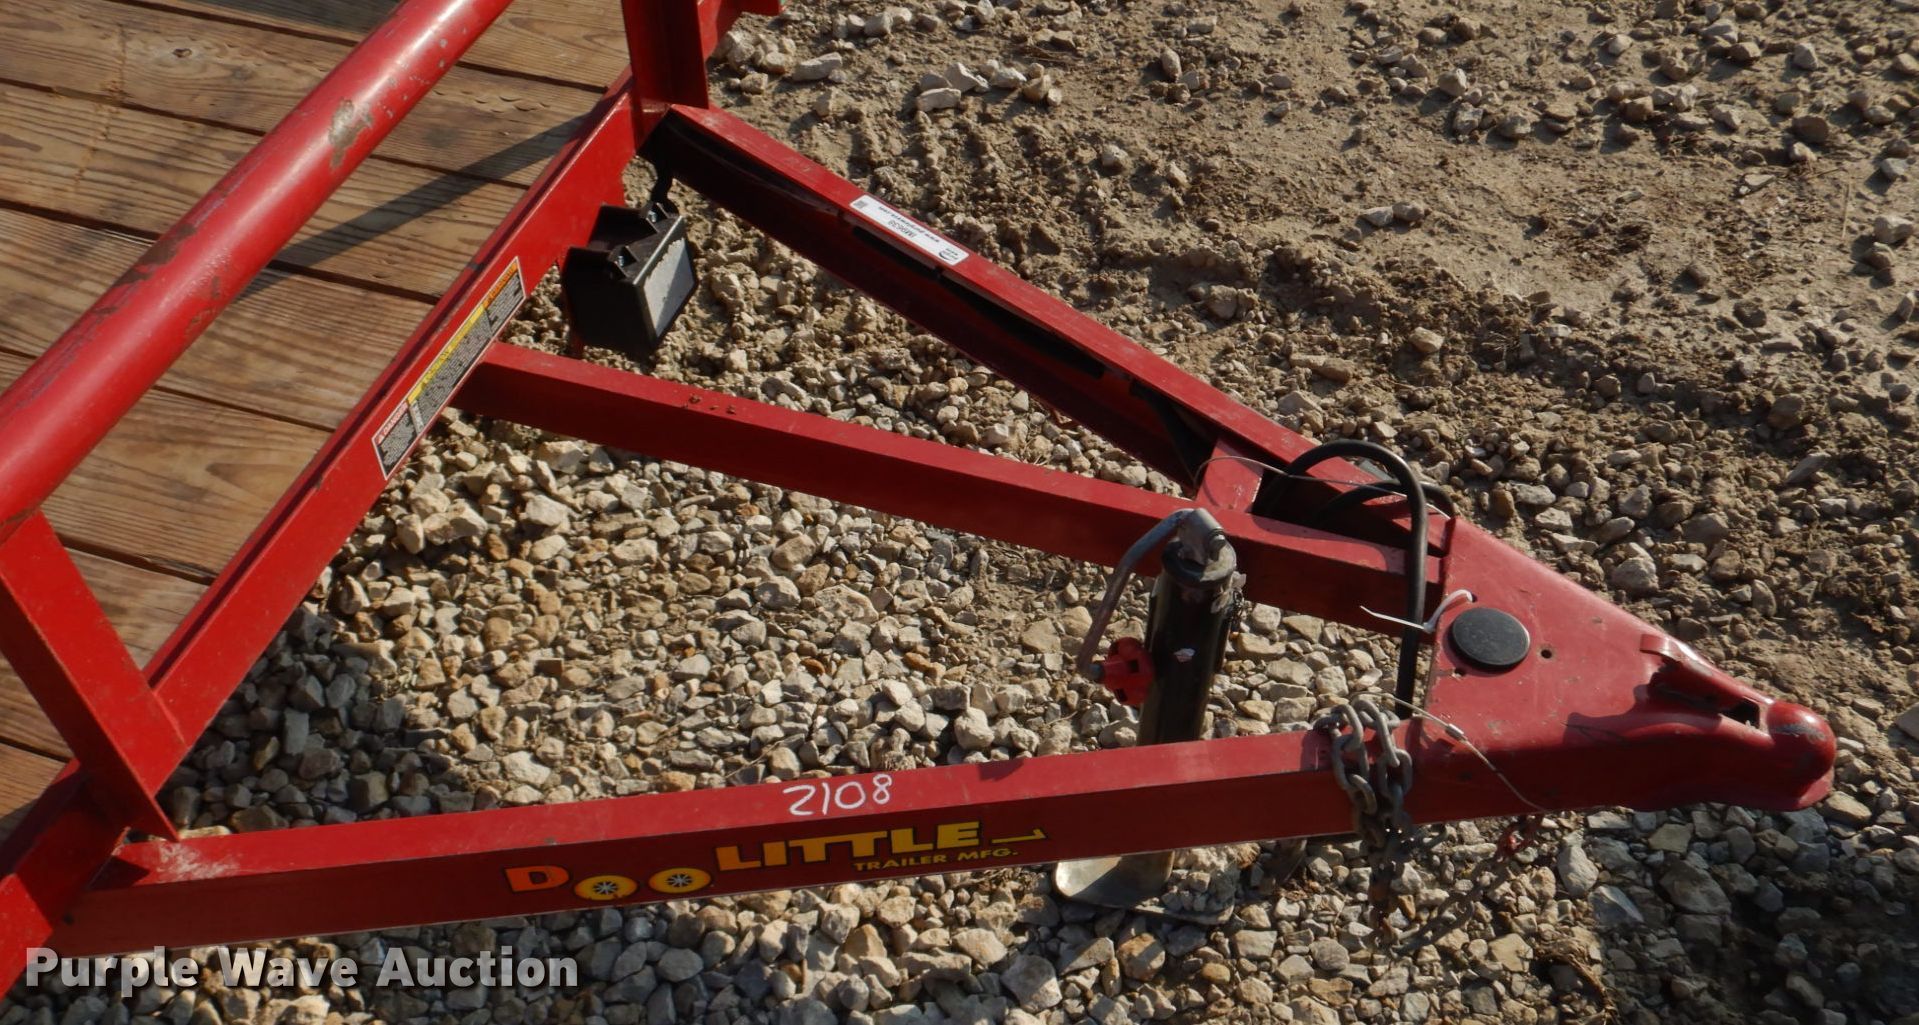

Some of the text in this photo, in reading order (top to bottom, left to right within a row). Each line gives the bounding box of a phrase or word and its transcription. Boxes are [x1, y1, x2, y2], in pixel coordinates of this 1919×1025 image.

[783, 774, 893, 816] 2108
[853, 848, 1019, 872] TRAILER MFG.
